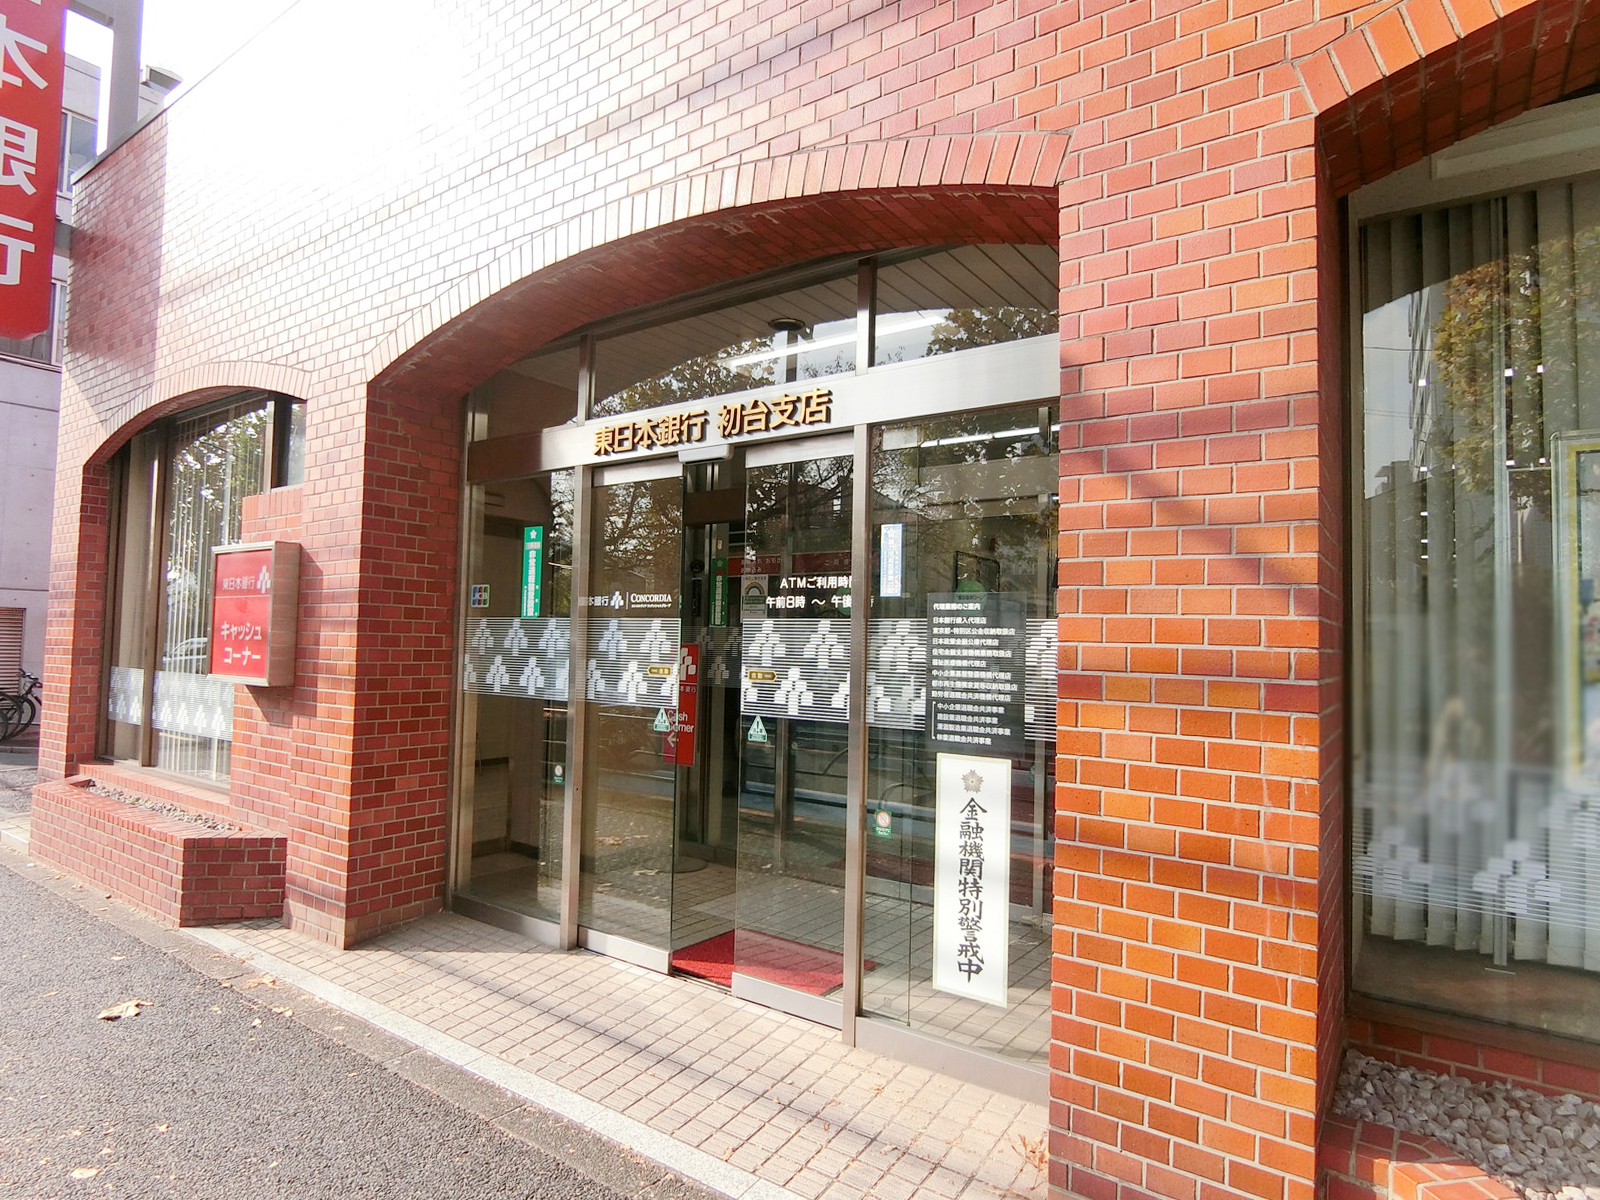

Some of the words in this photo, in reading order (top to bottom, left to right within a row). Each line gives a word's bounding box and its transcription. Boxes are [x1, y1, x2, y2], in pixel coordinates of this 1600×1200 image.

[593, 409, 708, 456] 東日本銀行
[716, 388, 832, 438] 初台支店
[222, 576, 255, 590] 東日本銀行
[780, 576, 852, 590] ATMご利用時
[588, 595, 609, 607] 本銀行
[630, 593, 672, 603] CONCORDIA
[765, 595, 806, 609] 午前8時
[831, 594, 852, 608] 午後
[221, 621, 262, 642] キャッシュ
[224, 646, 262, 666] コーナー
[957, 797, 988, 984] 金融機関特別警戒中
